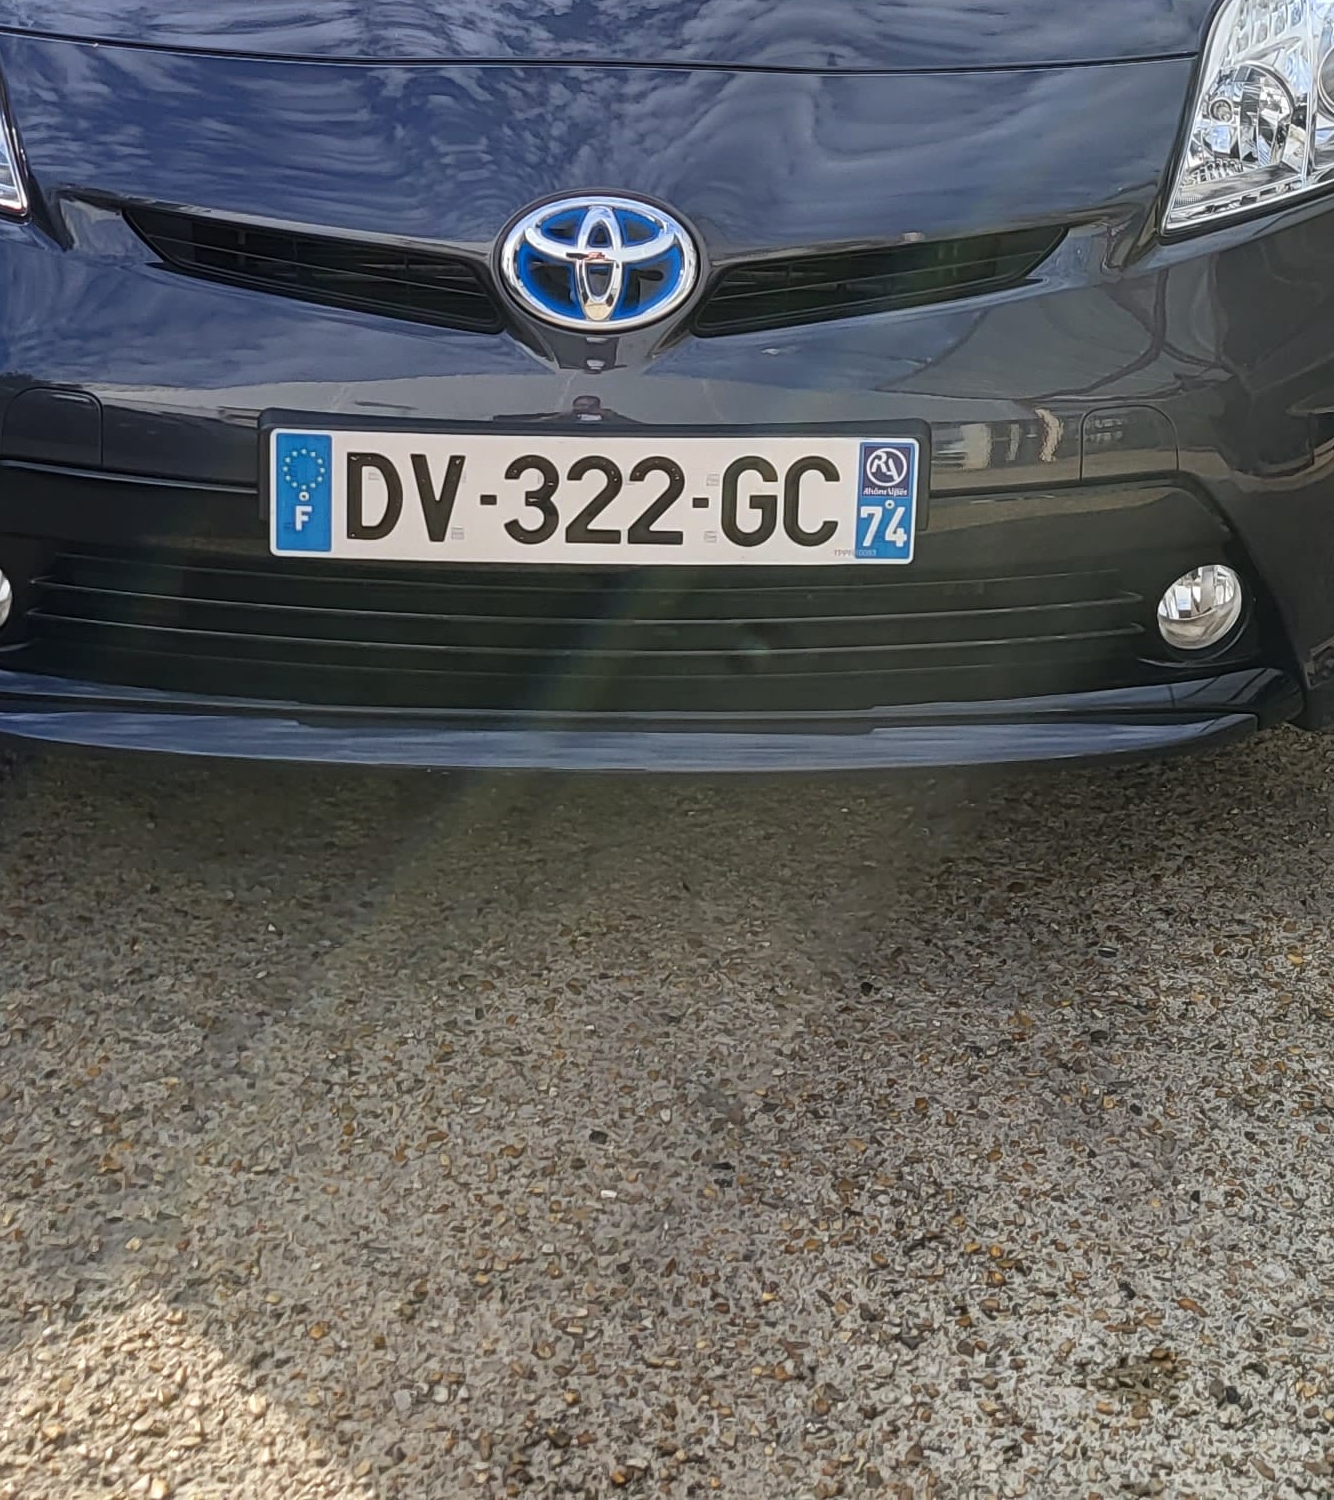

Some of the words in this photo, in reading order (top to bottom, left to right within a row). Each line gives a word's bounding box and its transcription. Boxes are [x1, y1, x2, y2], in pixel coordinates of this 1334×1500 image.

[295, 506, 312, 531] F
[346, 452, 841, 548] DV-322-GC
[860, 506, 908, 548] 74
